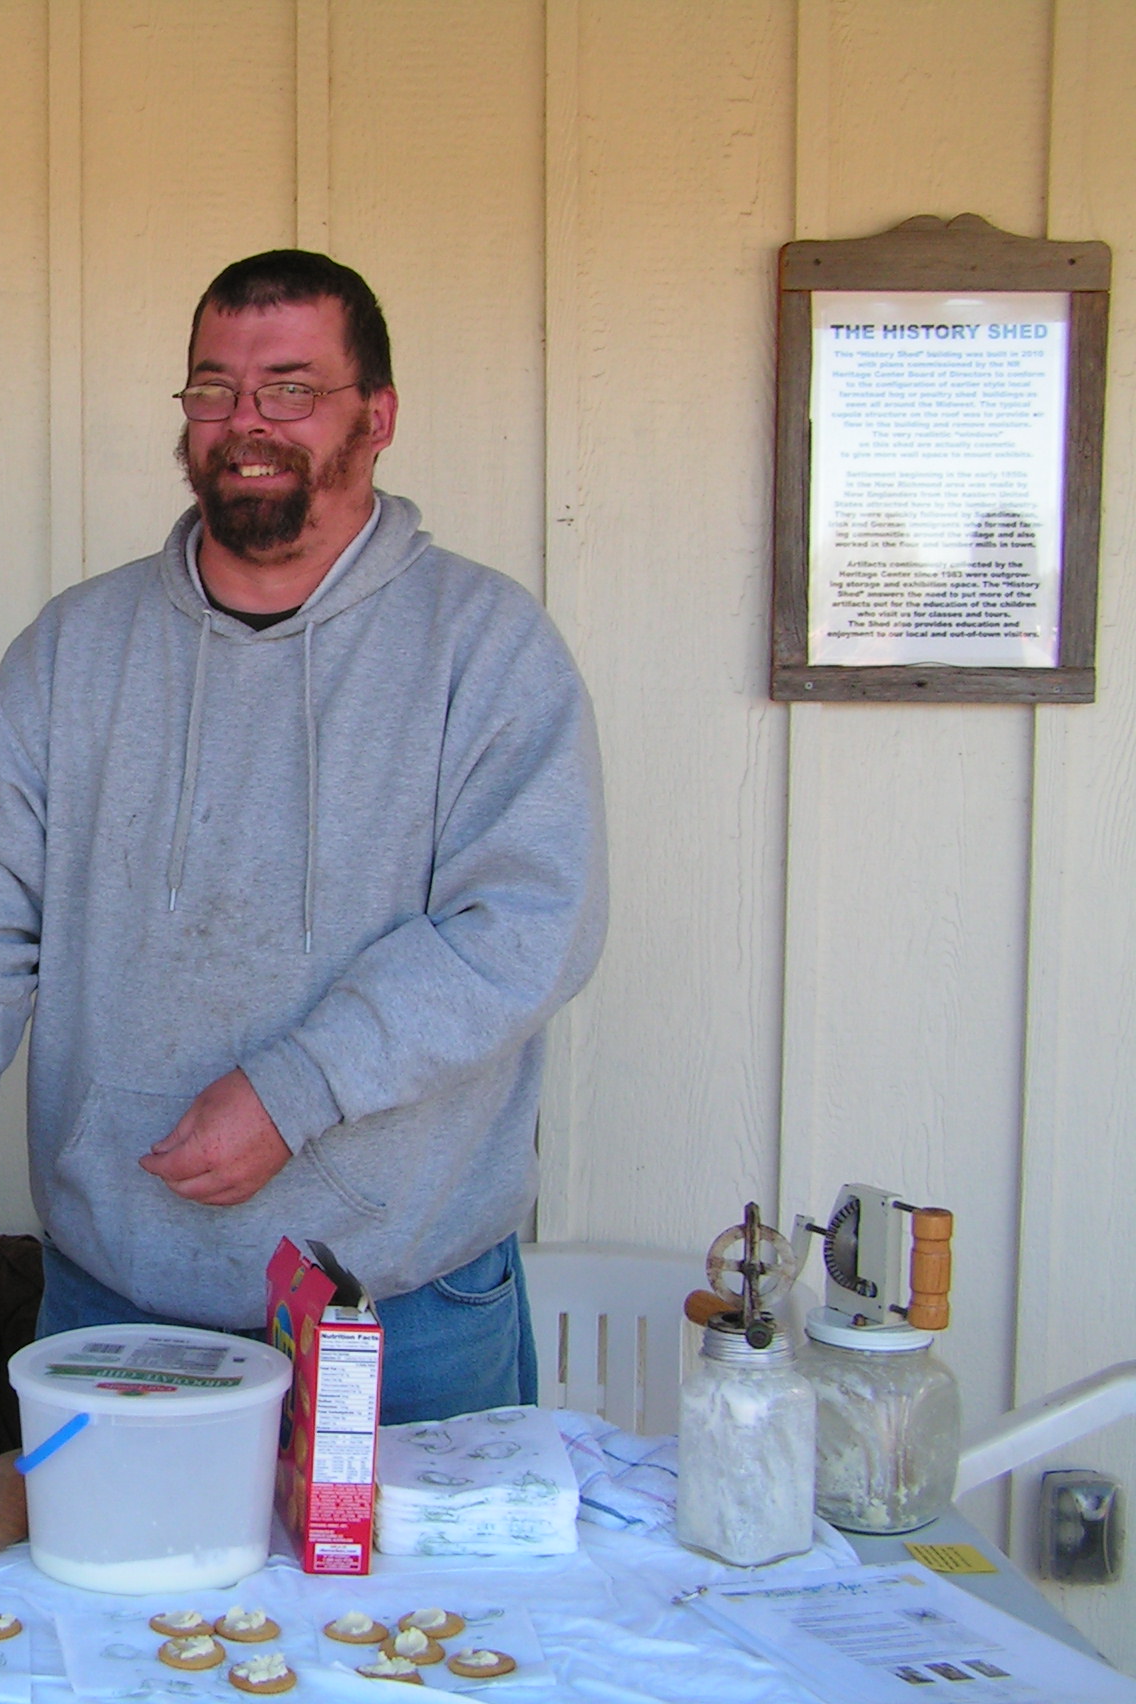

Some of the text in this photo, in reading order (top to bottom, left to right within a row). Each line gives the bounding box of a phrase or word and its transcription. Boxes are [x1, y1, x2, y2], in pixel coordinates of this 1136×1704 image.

[830, 323, 1048, 340] THE HISTORY SHED
[832, 600, 1036, 608] artifacts out for the education of the children
[857, 610, 876, 618] who
[879, 610, 898, 618] visit
[914, 610, 926, 618] for
[929, 610, 963, 618] classes
[966, 610, 982, 618] and
[985, 610, 1010, 618] tours.
[848, 620, 1019, 629] The Shed also provides education and
[827, 630, 874, 639] enjoyment
